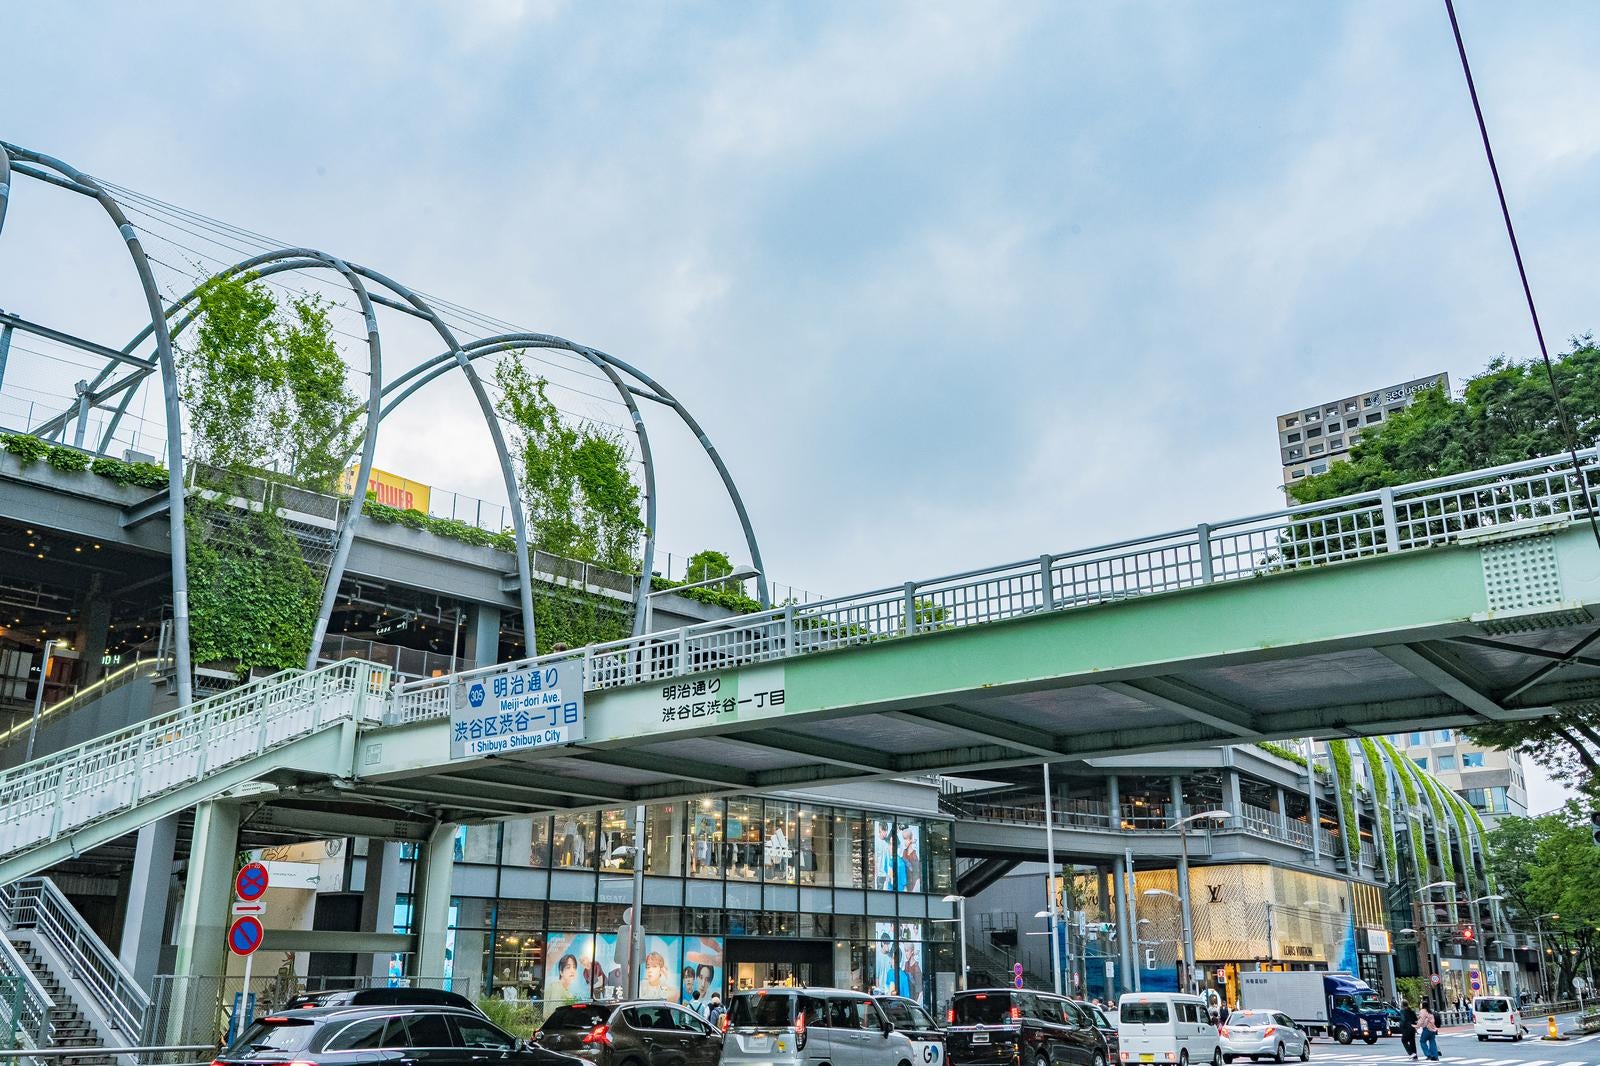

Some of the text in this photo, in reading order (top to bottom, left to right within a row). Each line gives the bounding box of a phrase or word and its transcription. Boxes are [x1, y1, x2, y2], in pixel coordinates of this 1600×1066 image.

[1385, 381, 1436, 400] sequence
[494, 667, 558, 698] 明治通り
[662, 678, 721, 700] 明治通り
[470, 690, 483, 701] 305
[500, 693, 560, 712] Meiji-dori Ave.
[662, 689, 785, 722] 渋谷区渋谷一丁目
[455, 702, 578, 741] 渋谷区渋谷一丁目
[471, 730, 561, 752] 1 Shibuya Shibuya City
[1283, 945, 1312, 957] LOUIS VUITTON
